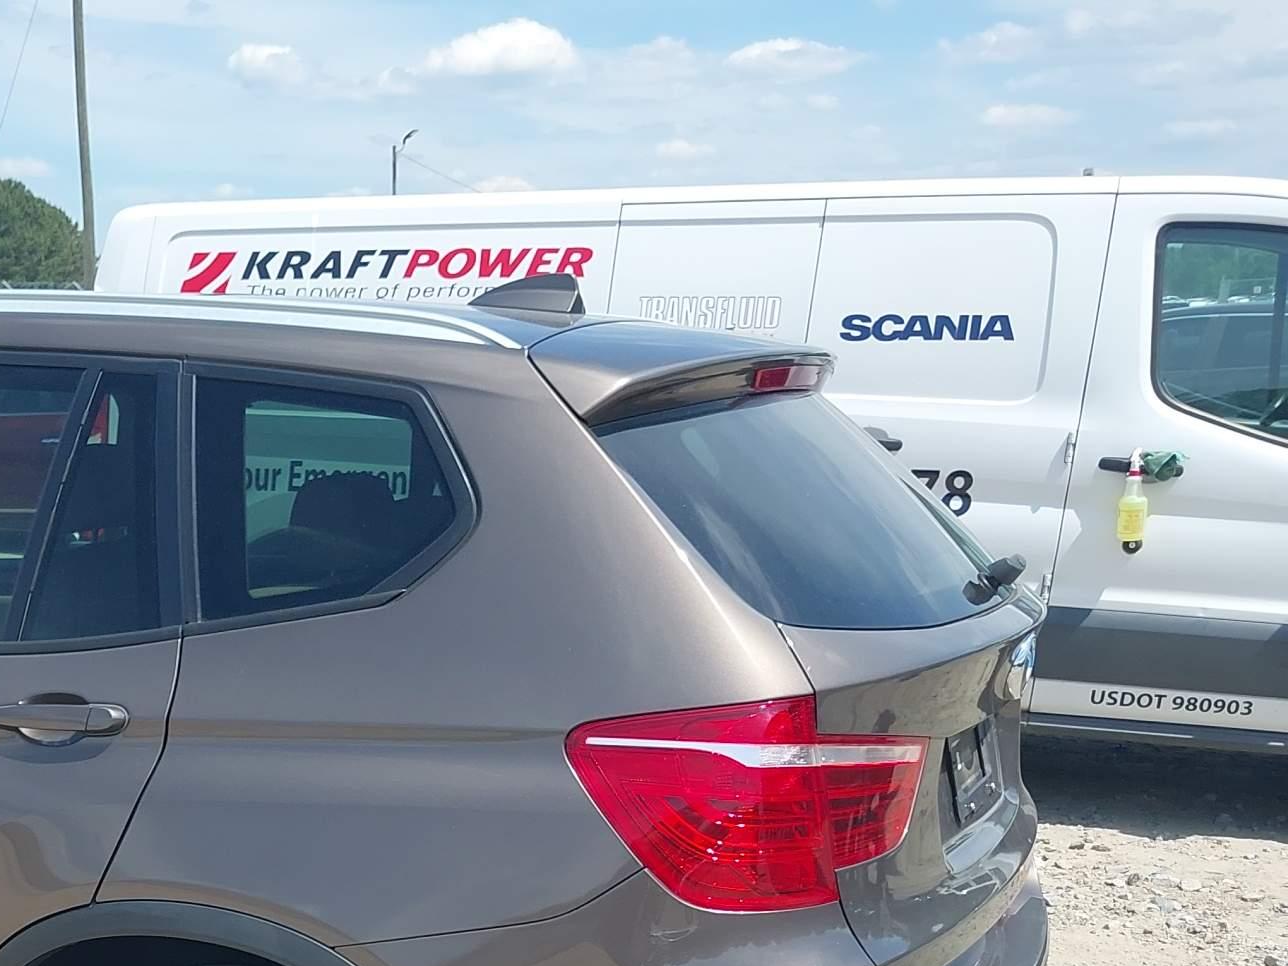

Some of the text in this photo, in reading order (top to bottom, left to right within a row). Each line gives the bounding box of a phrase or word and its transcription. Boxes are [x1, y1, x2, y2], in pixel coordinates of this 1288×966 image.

[241, 247, 593, 280] KRAFTPOWER
[376, 284, 400, 300] of
[639, 296, 782, 331] TRANSFLUID
[839, 314, 1015, 342] SCANIA
[1090, 689, 1255, 716] USDOT 980903
